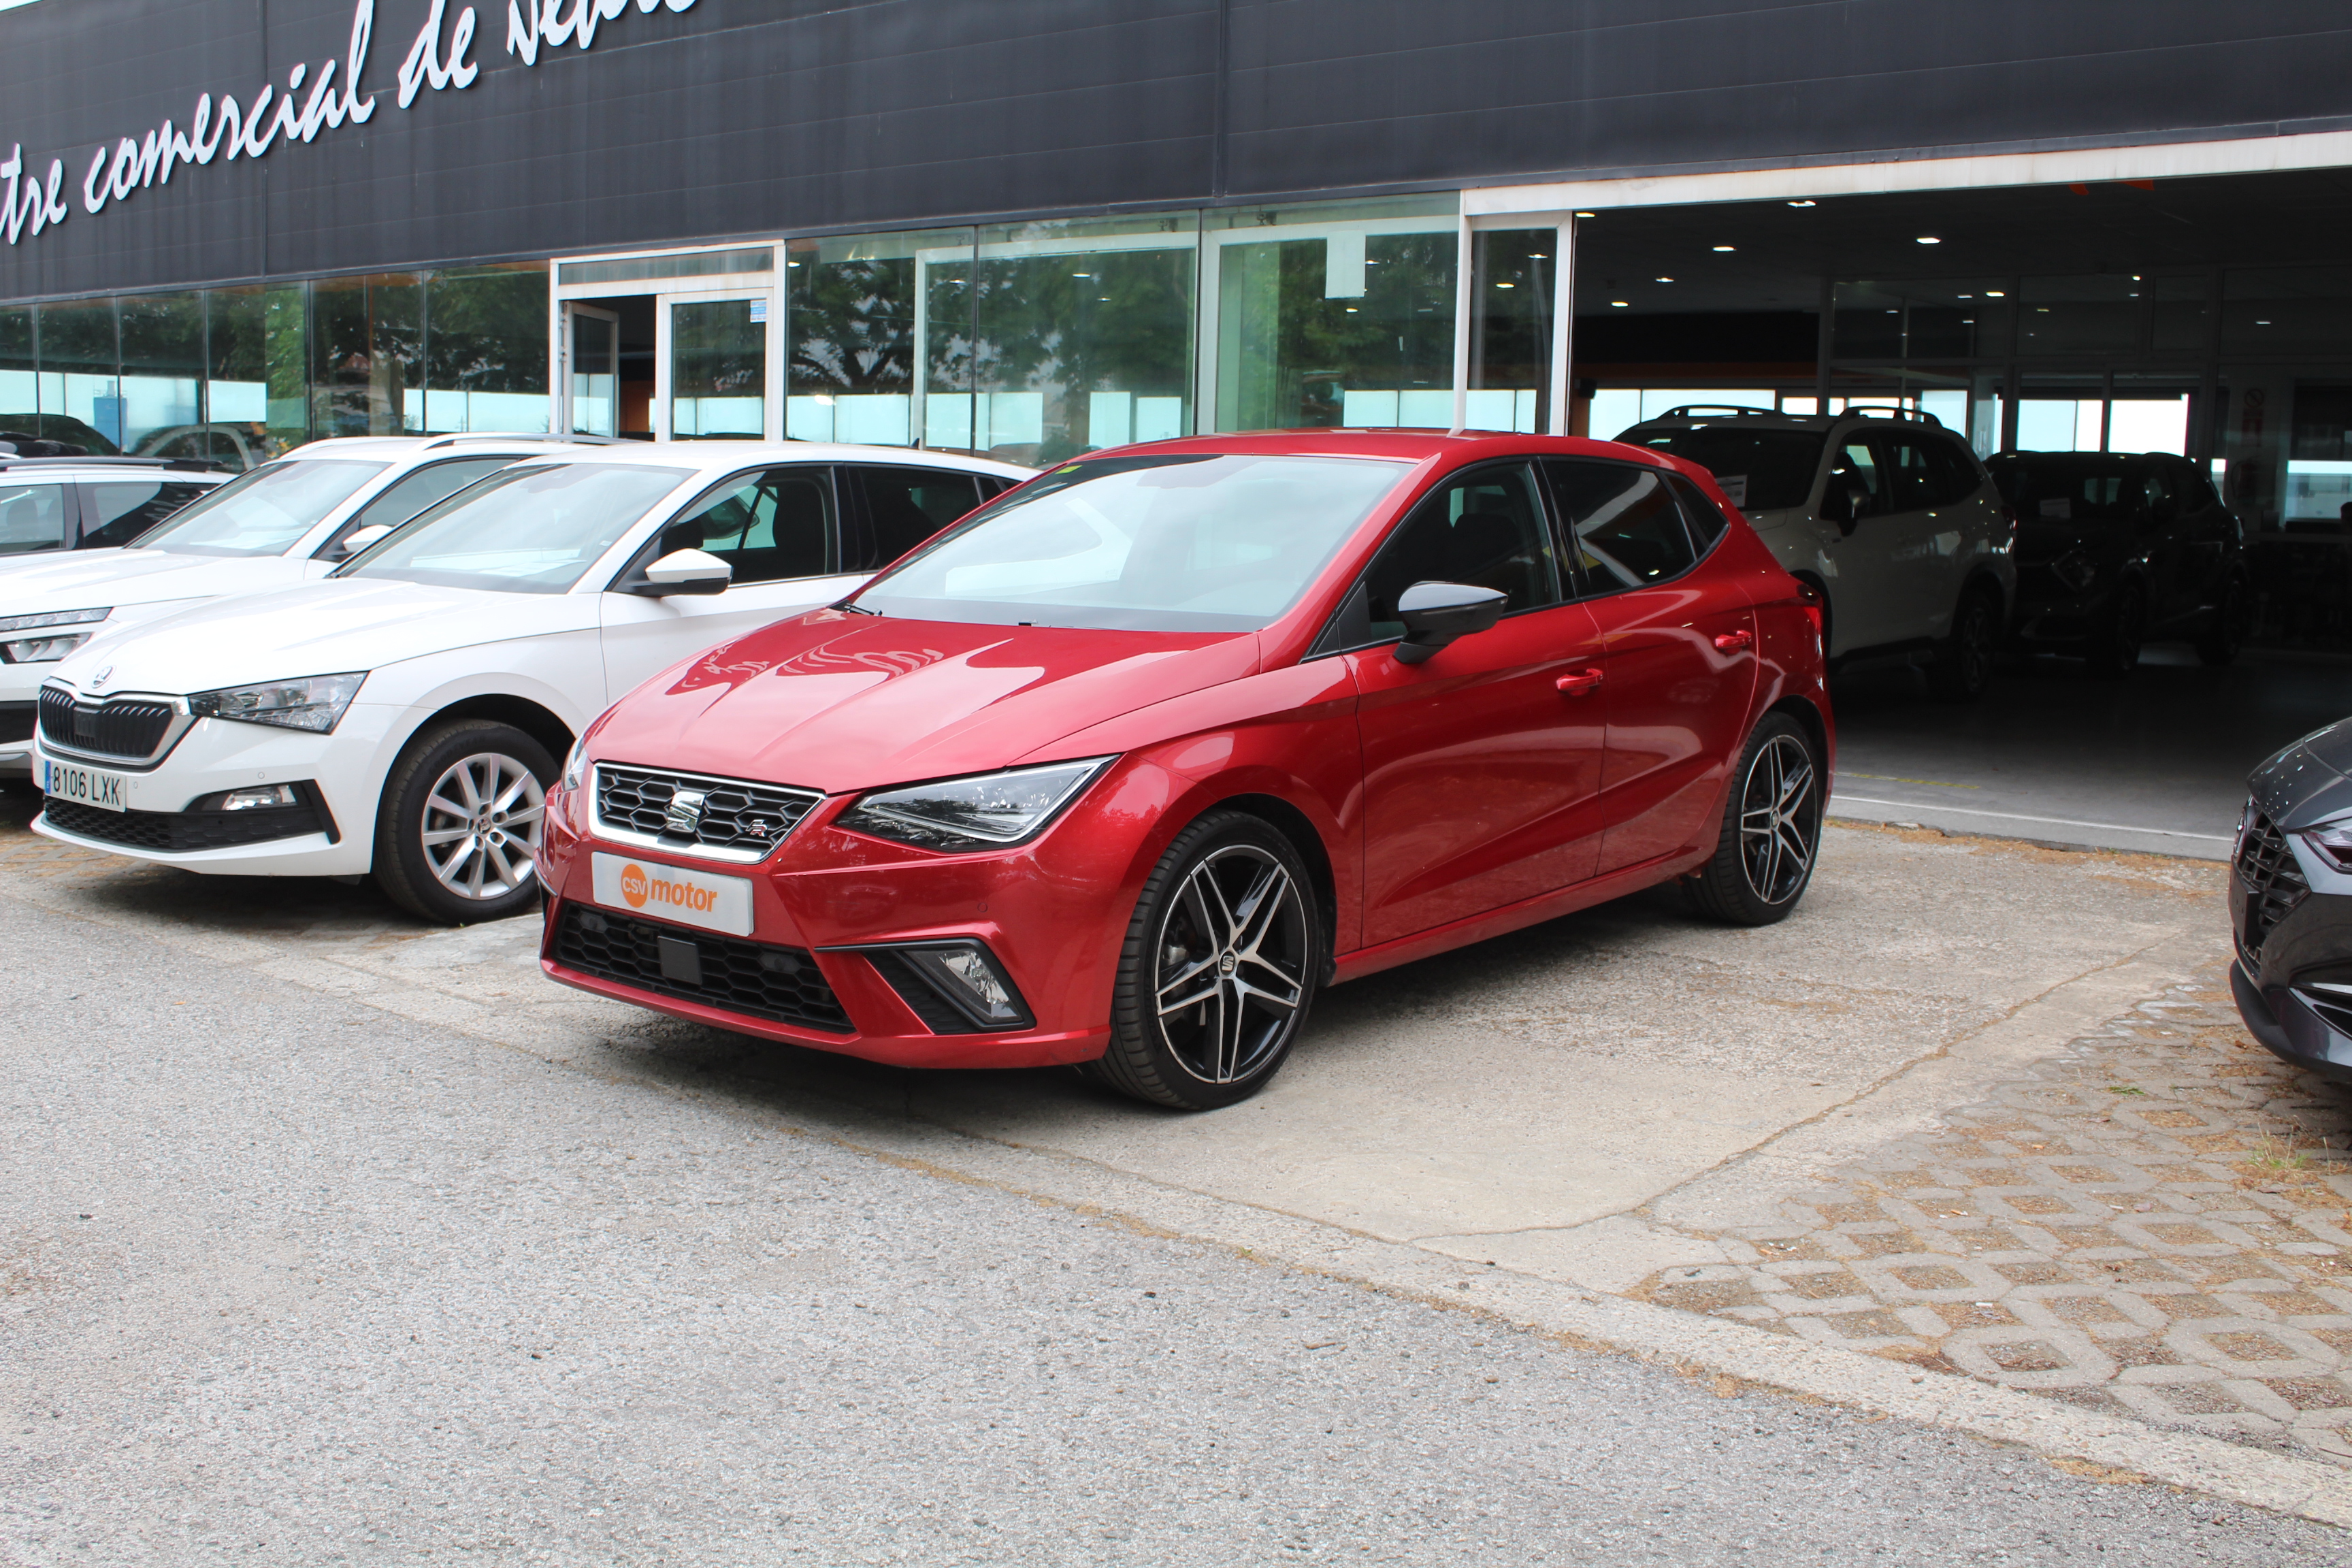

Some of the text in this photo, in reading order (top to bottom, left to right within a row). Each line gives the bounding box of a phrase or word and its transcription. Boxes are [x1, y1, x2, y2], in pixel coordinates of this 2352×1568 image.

[84, 0, 376, 214] comercial
[397, 0, 478, 109] de
[53, 766, 120, 806] 8106 LXK
[650, 879, 717, 912] motor
